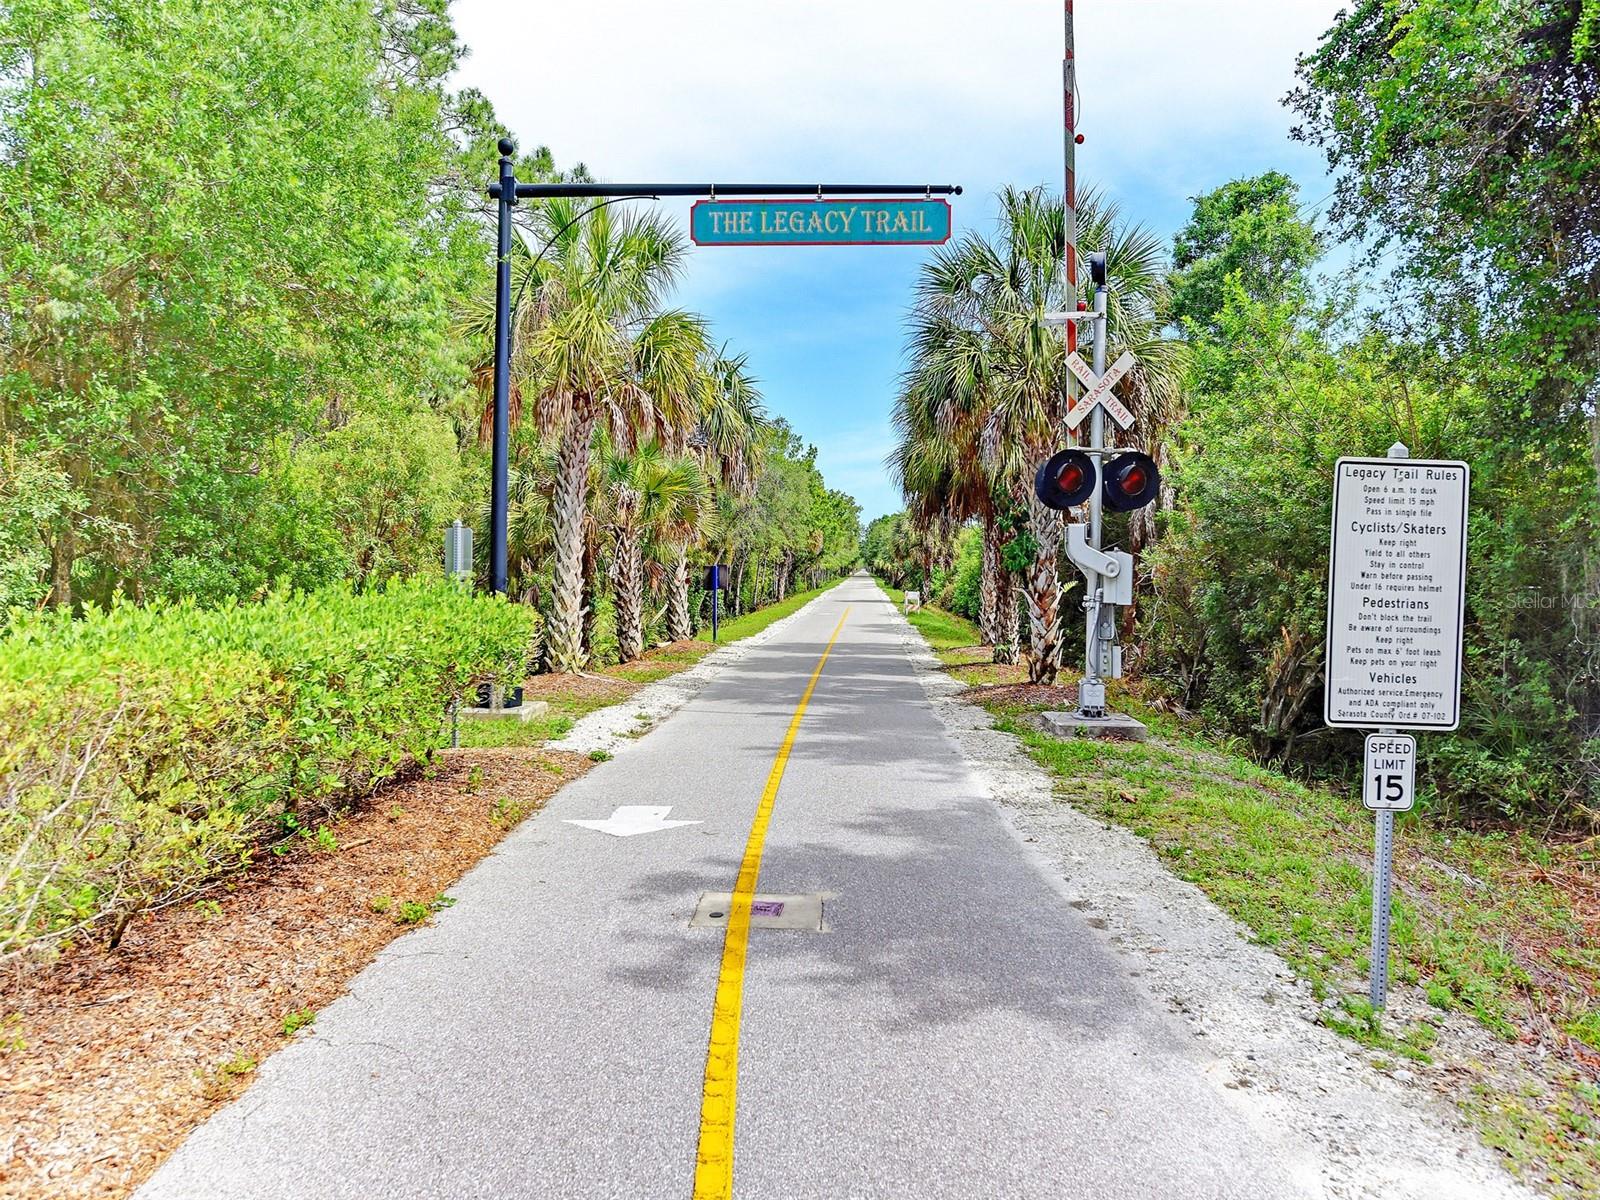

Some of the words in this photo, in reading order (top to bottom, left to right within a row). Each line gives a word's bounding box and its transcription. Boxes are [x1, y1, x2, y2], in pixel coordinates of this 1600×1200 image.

[709, 210, 752, 234] THE
[761, 206, 857, 234] LEGACY
[861, 210, 932, 234] TRAIL
[1071, 359, 1090, 382] RAIL
[1078, 368, 1121, 414] SARASOTA
[1106, 396, 1128, 424] TRAIL
[1346, 467, 1386, 480] Legacy
[1393, 468, 1418, 480] Trail
[1426, 470, 1457, 480] Rules
[1363, 484, 1380, 494] Open
[1364, 496, 1384, 505] Speed
[1420, 498, 1434, 506] mph
[1396, 508, 1416, 518] single
[1420, 509, 1432, 517] file
[1351, 521, 1446, 535] Cyclists/Skaters
[1379, 538, 1396, 547] Keep
[1400, 539, 1416, 548] right
[1364, 549, 1382, 557] Yield
[1370, 560, 1384, 568] Stay
[1406, 574, 1432, 582] passing
[1350, 582, 1371, 590] Under
[1386, 584, 1414, 592] requires
[1362, 597, 1430, 610] Pedestrians
[1358, 612, 1376, 620] Don't
[1396, 626, 1441, 635] surroundings
[1376, 636, 1392, 644] Keep
[1396, 637, 1414, 646] right
[1350, 658, 1367, 666] Keep
[1370, 658, 1385, 666] pets
[1400, 660, 1416, 668] your
[1420, 660, 1437, 669] right
[1370, 672, 1417, 684] Vehicles
[1338, 688, 1374, 696] Authorized
[1382, 700, 1416, 708] compliant
[1420, 702, 1435, 710] only
[1338, 710, 1367, 718] Sarasota
[1370, 710, 1395, 720] County
[1422, 712, 1446, 720] 07-102
[1370, 743, 1411, 754] SPEED
[1374, 759, 1406, 770] LIMIT
[1374, 774, 1404, 802] 15
